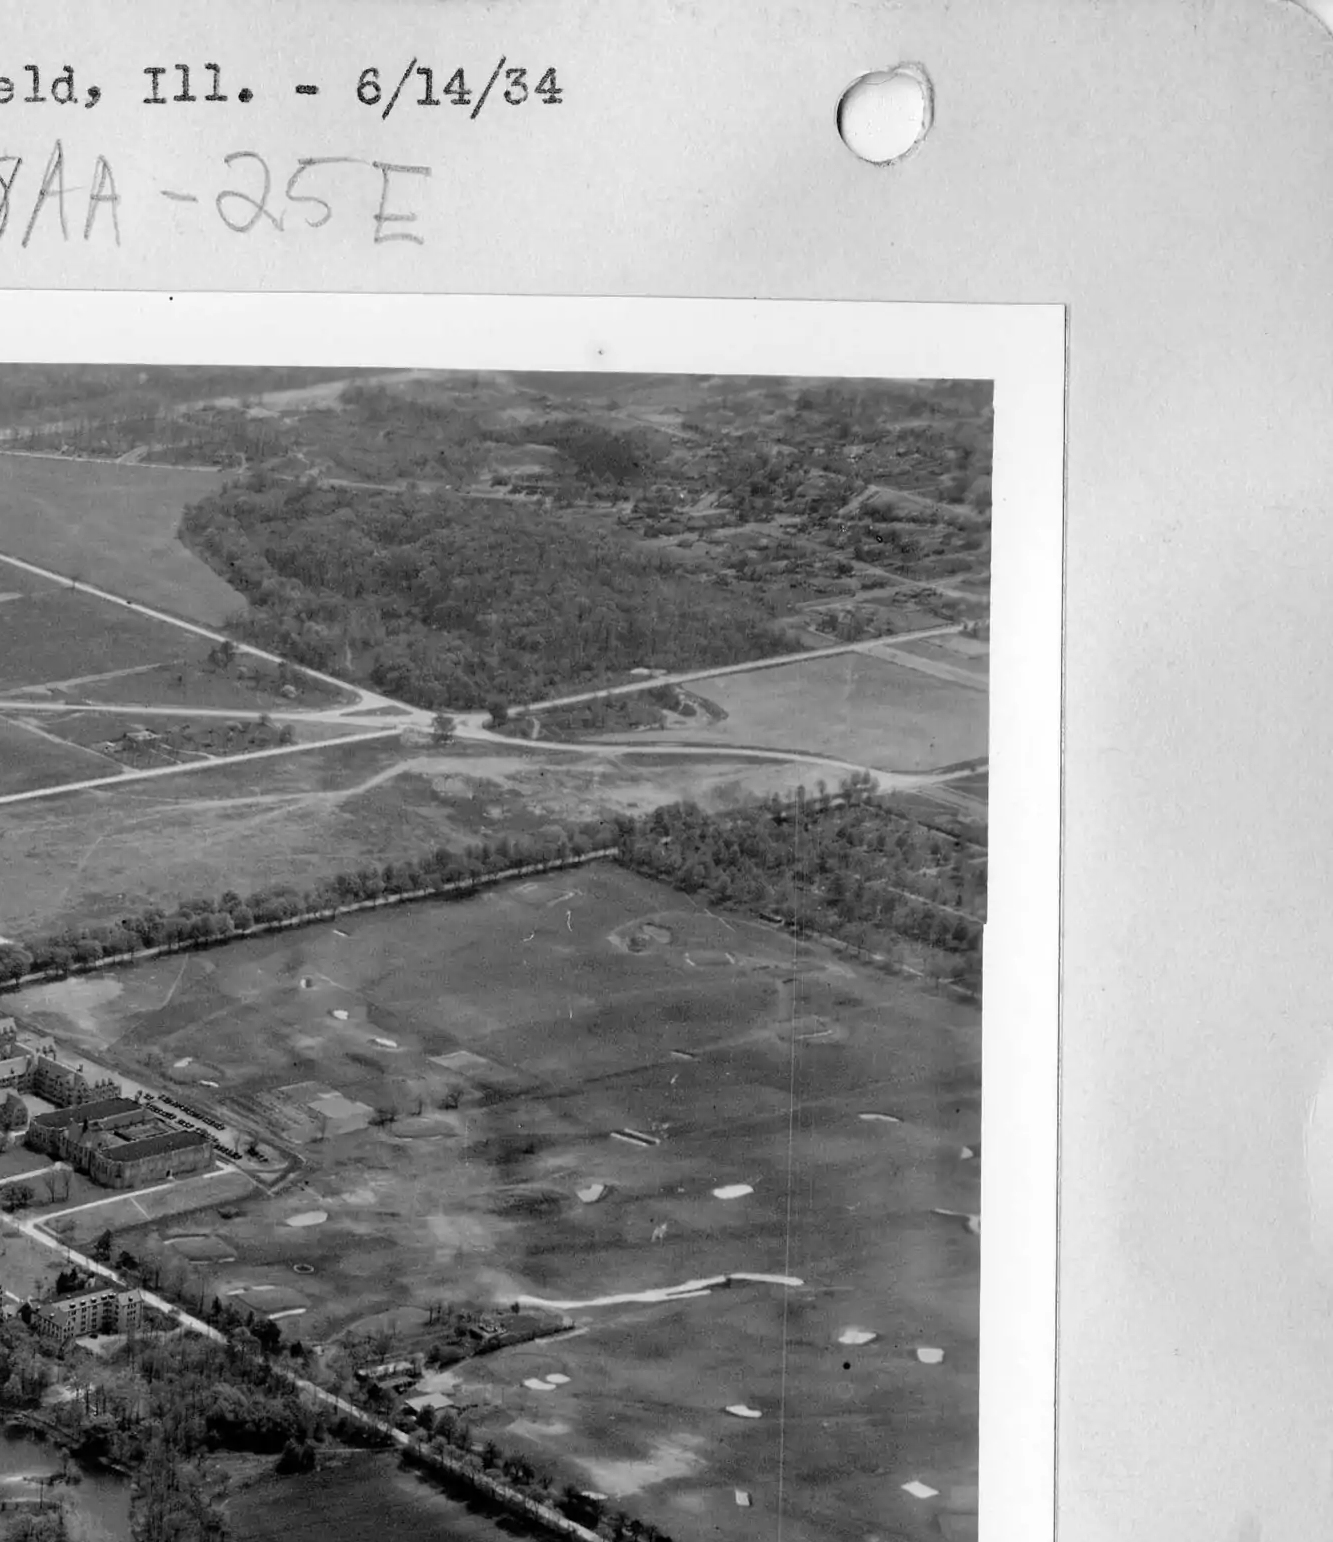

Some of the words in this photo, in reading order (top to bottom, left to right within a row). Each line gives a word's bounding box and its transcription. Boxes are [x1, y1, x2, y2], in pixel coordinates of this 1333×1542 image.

[142, 62, 254, 105] Ill.
[294, 83, 320, 96] -
[356, 55, 564, 118] 6/14/34
